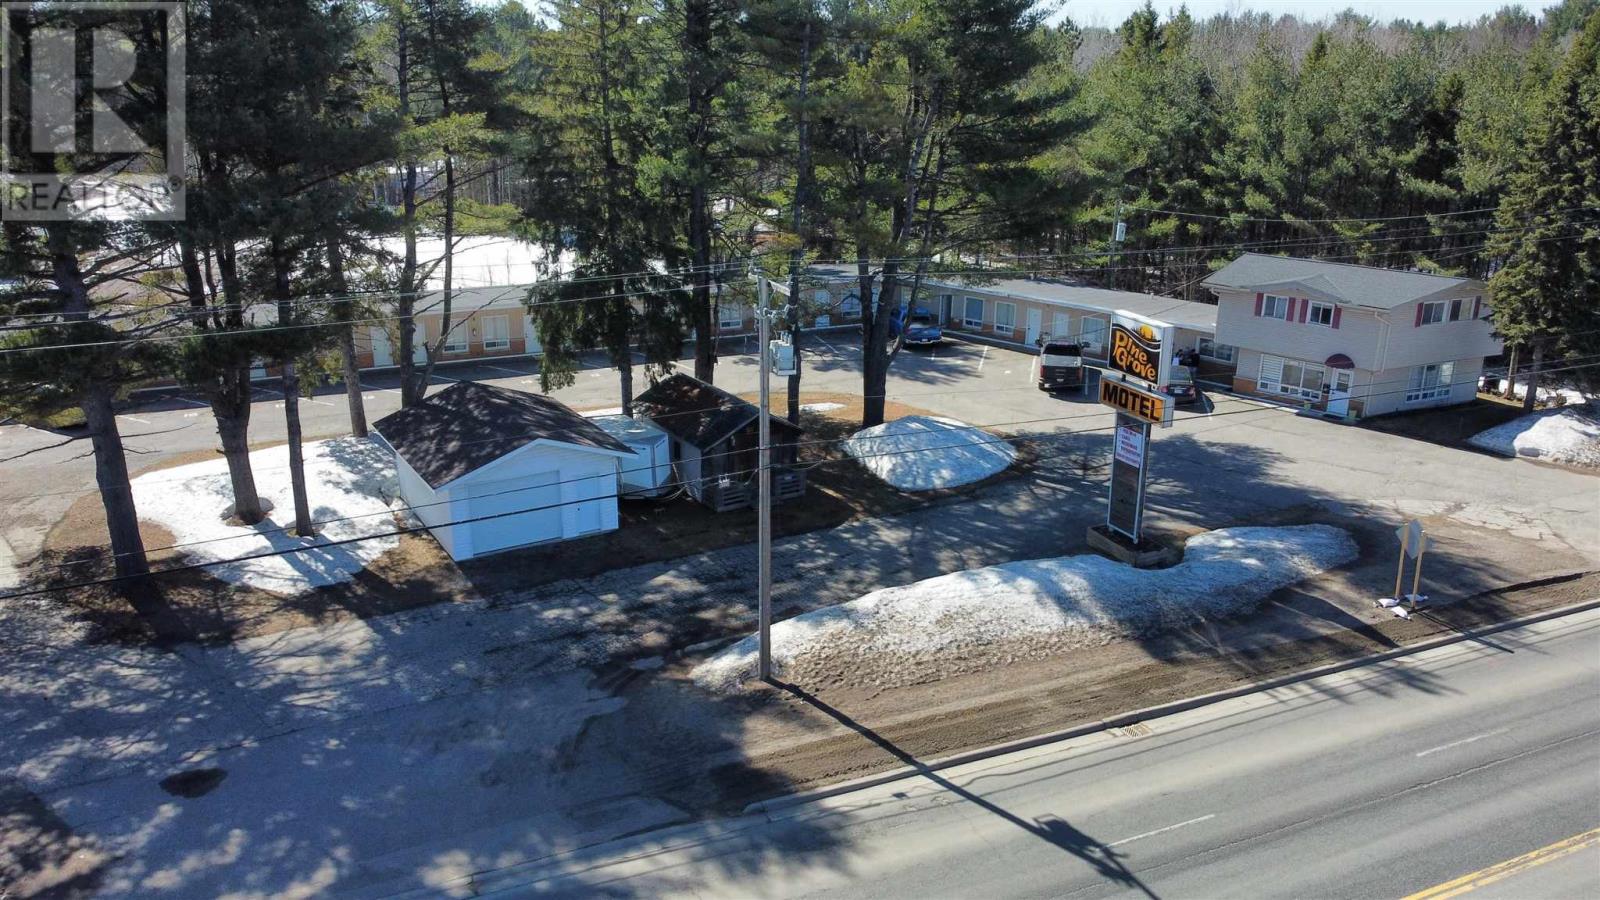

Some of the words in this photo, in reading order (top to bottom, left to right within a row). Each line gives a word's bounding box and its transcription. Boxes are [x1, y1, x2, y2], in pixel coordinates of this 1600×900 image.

[1113, 329, 1148, 364] Pine
[1115, 347, 1156, 381] Grove
[1102, 382, 1160, 422] MOTEL
